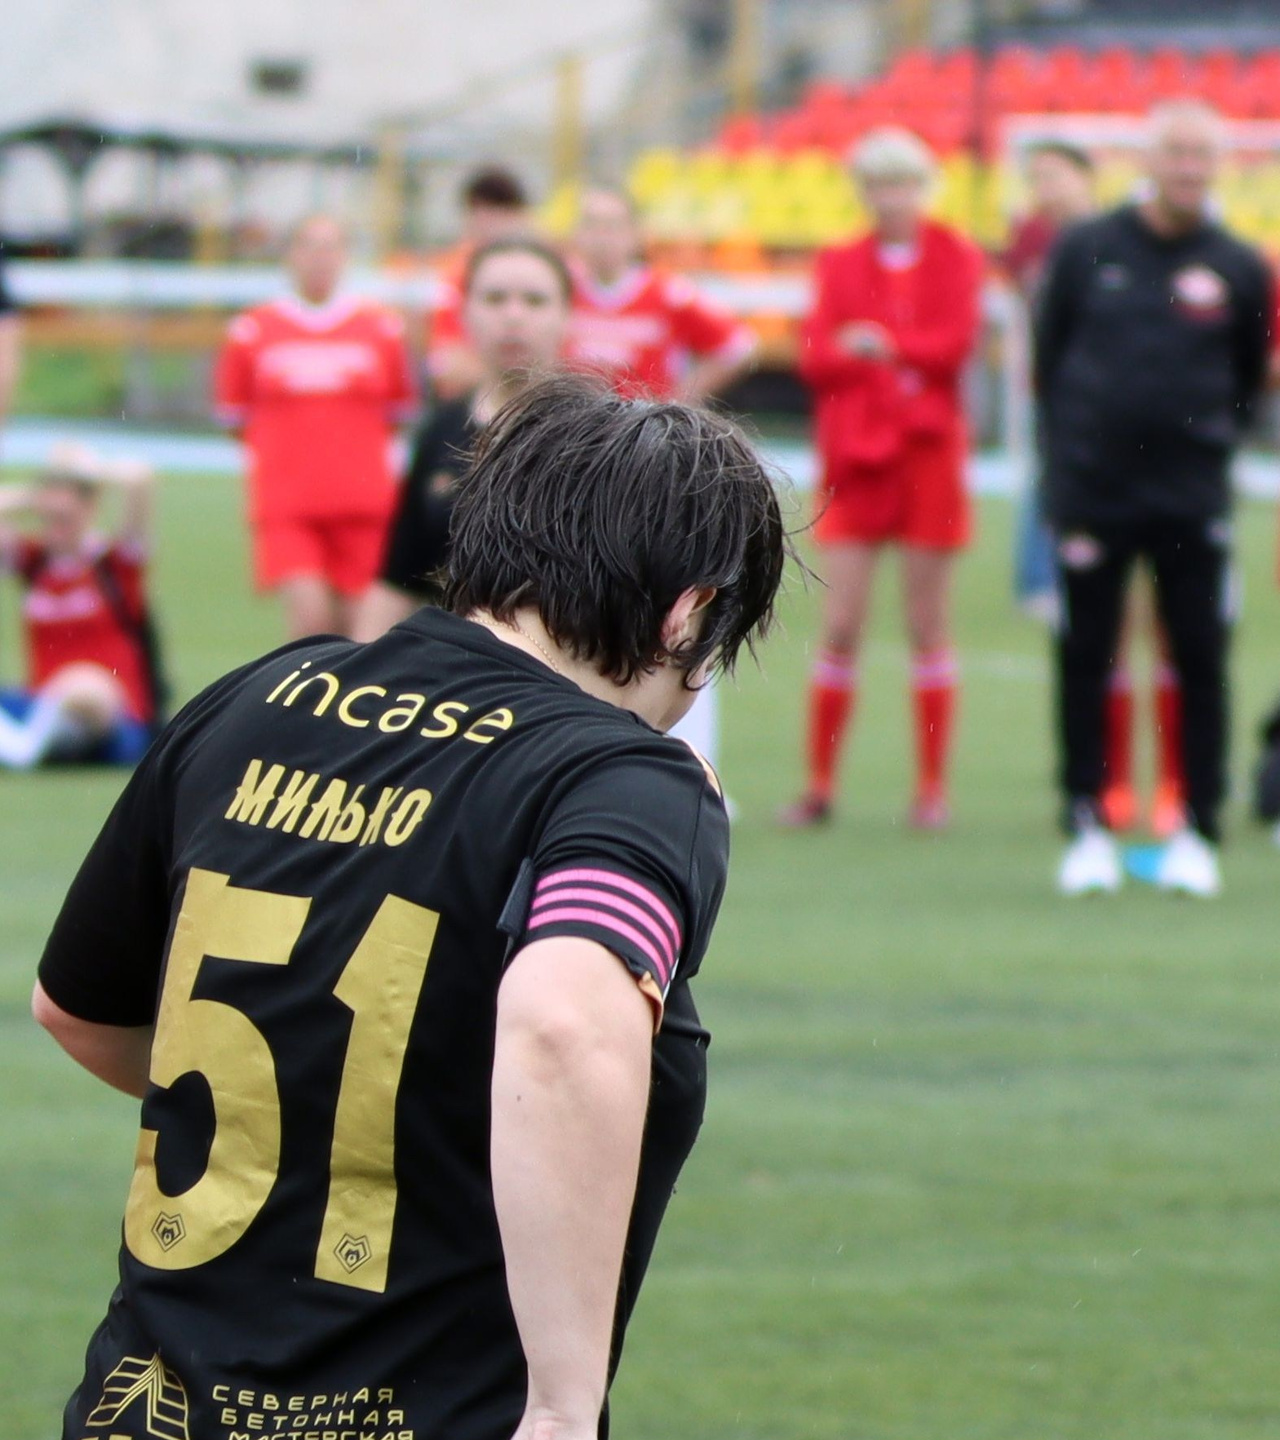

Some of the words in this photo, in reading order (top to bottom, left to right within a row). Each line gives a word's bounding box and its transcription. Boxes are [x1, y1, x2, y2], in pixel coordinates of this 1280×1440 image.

[266, 661, 514, 744] incase
[224, 759, 432, 847] МИЛЬКО
[124, 867, 441, 1294] 51
[212, 1385, 394, 1411] СЕВЕРНАЯ
[221, 1409, 404, 1431] БЕТОННАЯ
